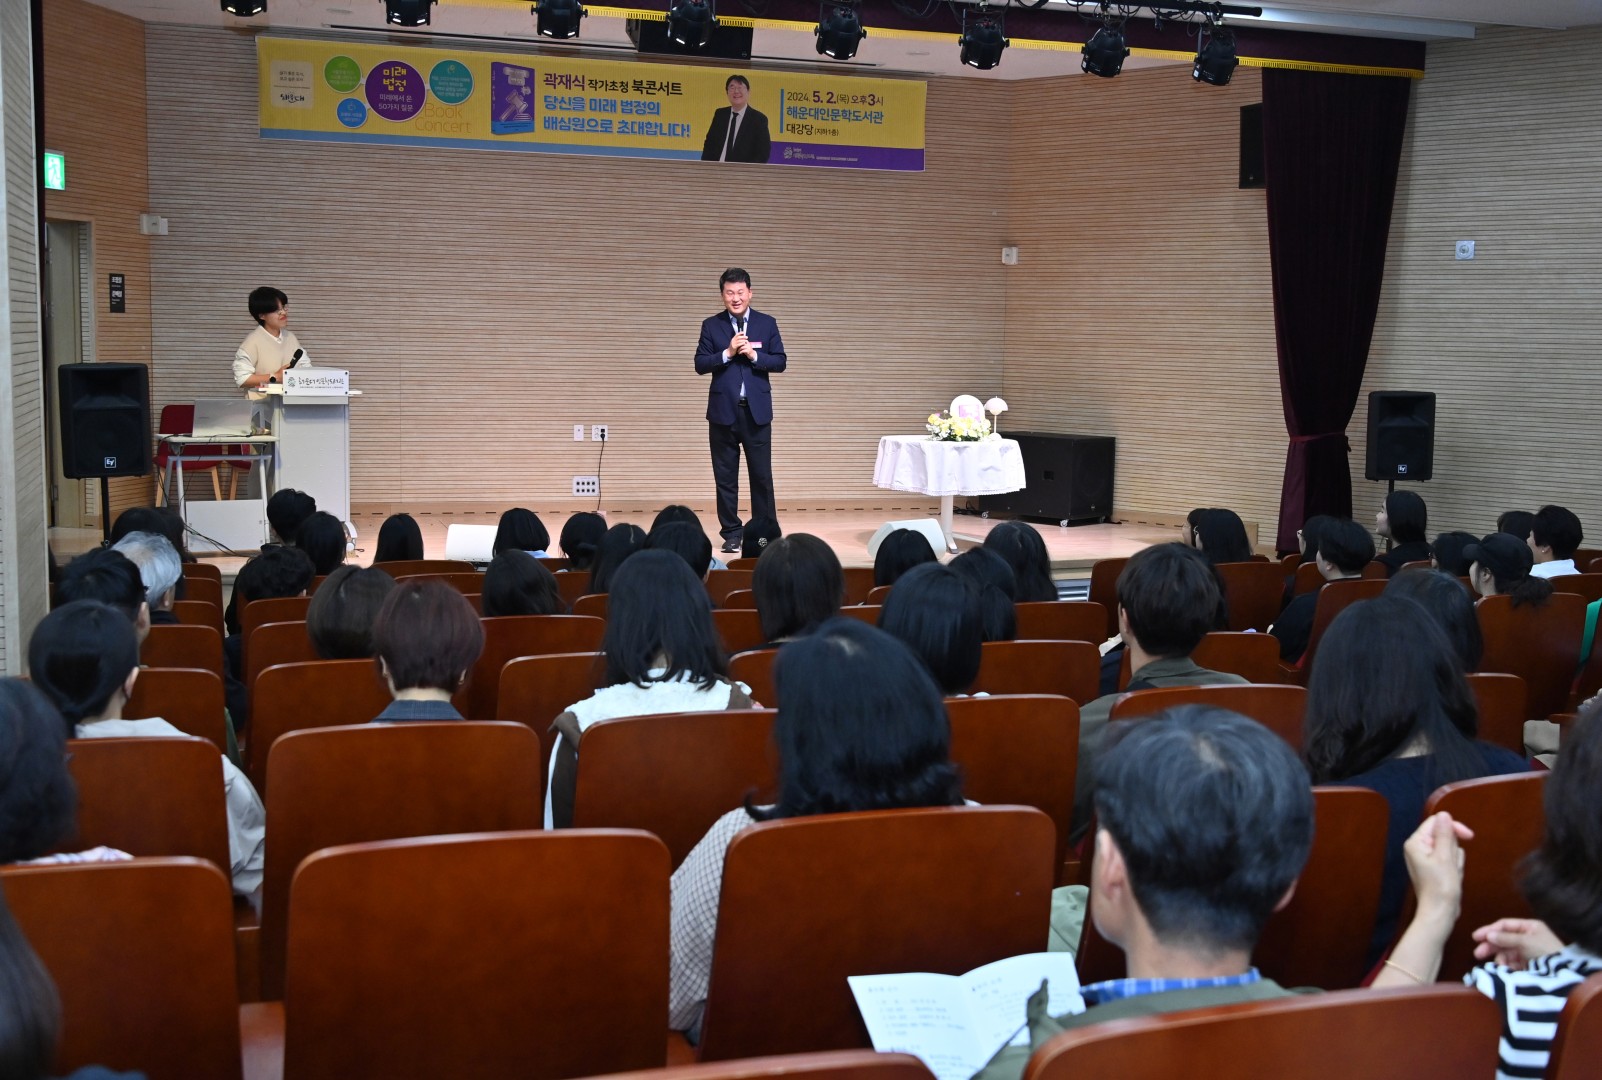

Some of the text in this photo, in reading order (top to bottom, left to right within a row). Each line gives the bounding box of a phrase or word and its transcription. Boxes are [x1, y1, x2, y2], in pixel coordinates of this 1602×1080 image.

[382, 66, 407, 77] 미래
[382, 77, 407, 92] 법정
[543, 73, 585, 91] 곽재식
[588, 79, 629, 94] 작가초청
[632, 79, 683, 96] 북콘서트
[379, 93, 413, 103] 미래에서 온
[787, 91, 811, 102] 2024.
[378, 103, 414, 112] 50가지 질문
[424, 102, 463, 119] Book
[543, 95, 661, 115] 당신을 미래 법정의
[786, 105, 884, 124] 해운대인문학도서관
[415, 116, 472, 133] Concert
[543, 116, 691, 138] 배심원으로 초대합니다!
[786, 123, 814, 136] 대강당
